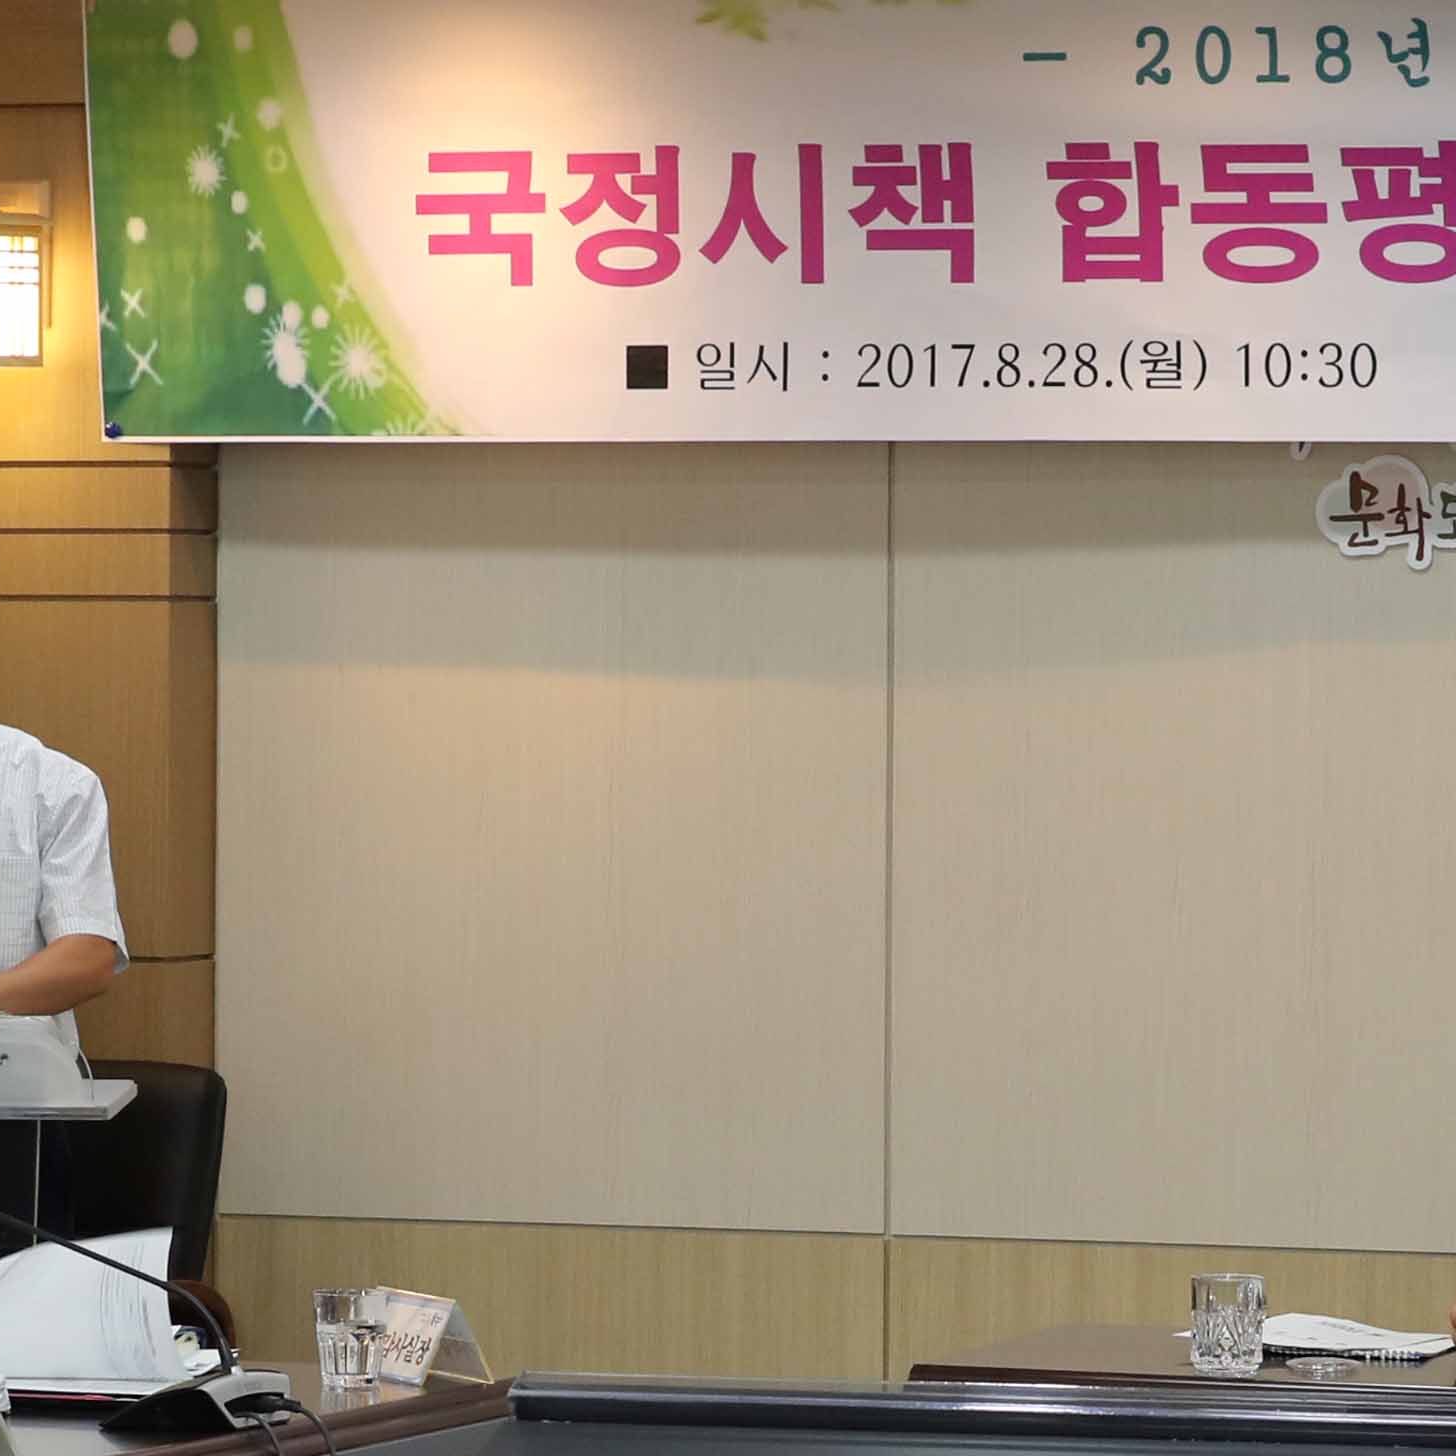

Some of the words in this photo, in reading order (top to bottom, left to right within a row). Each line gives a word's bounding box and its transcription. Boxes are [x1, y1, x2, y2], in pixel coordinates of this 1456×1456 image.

[1135, 18, 1432, 89] 2018년
[414, 142, 978, 288] 국정시책
[696, 341, 791, 393] 일시
[856, 339, 1209, 393] 2017.8.28.(월)
[1236, 342, 1379, 391] 10:30
